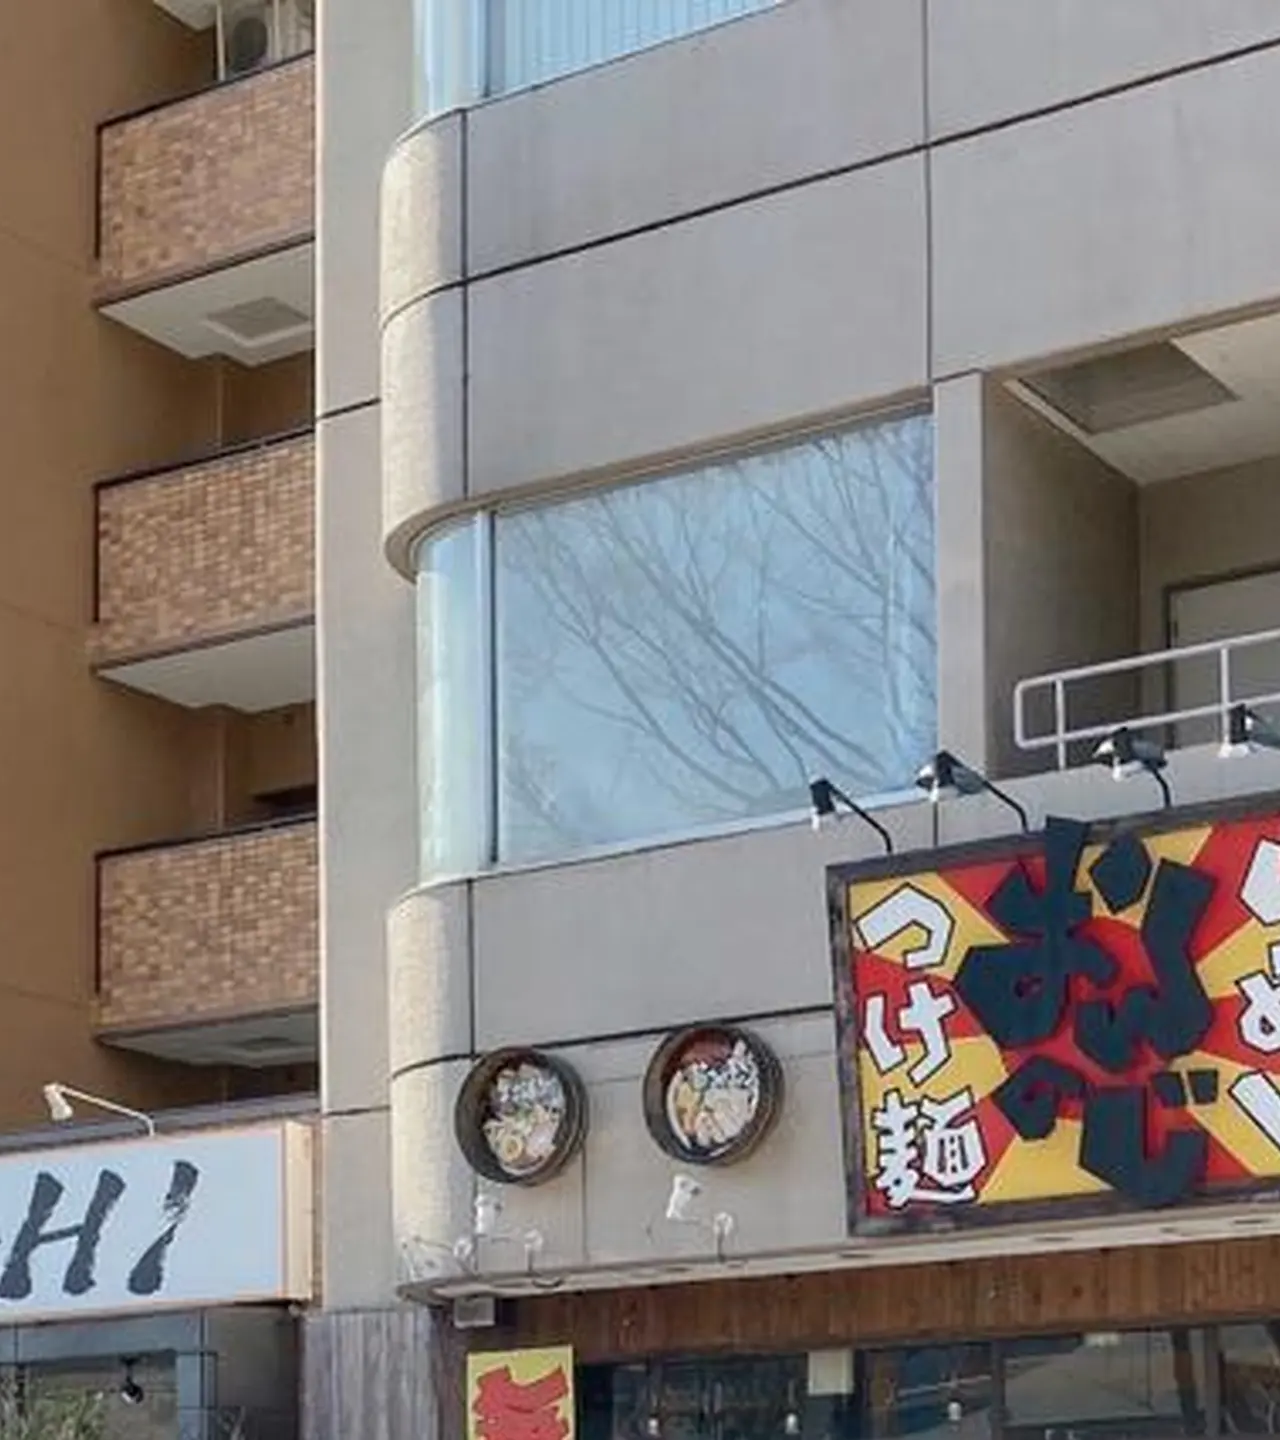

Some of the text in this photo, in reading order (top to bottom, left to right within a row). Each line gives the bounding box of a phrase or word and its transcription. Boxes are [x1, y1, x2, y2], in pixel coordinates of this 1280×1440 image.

[854, 881, 988, 1209] つけ麺
[954, 815, 1221, 1203] おんのじ
